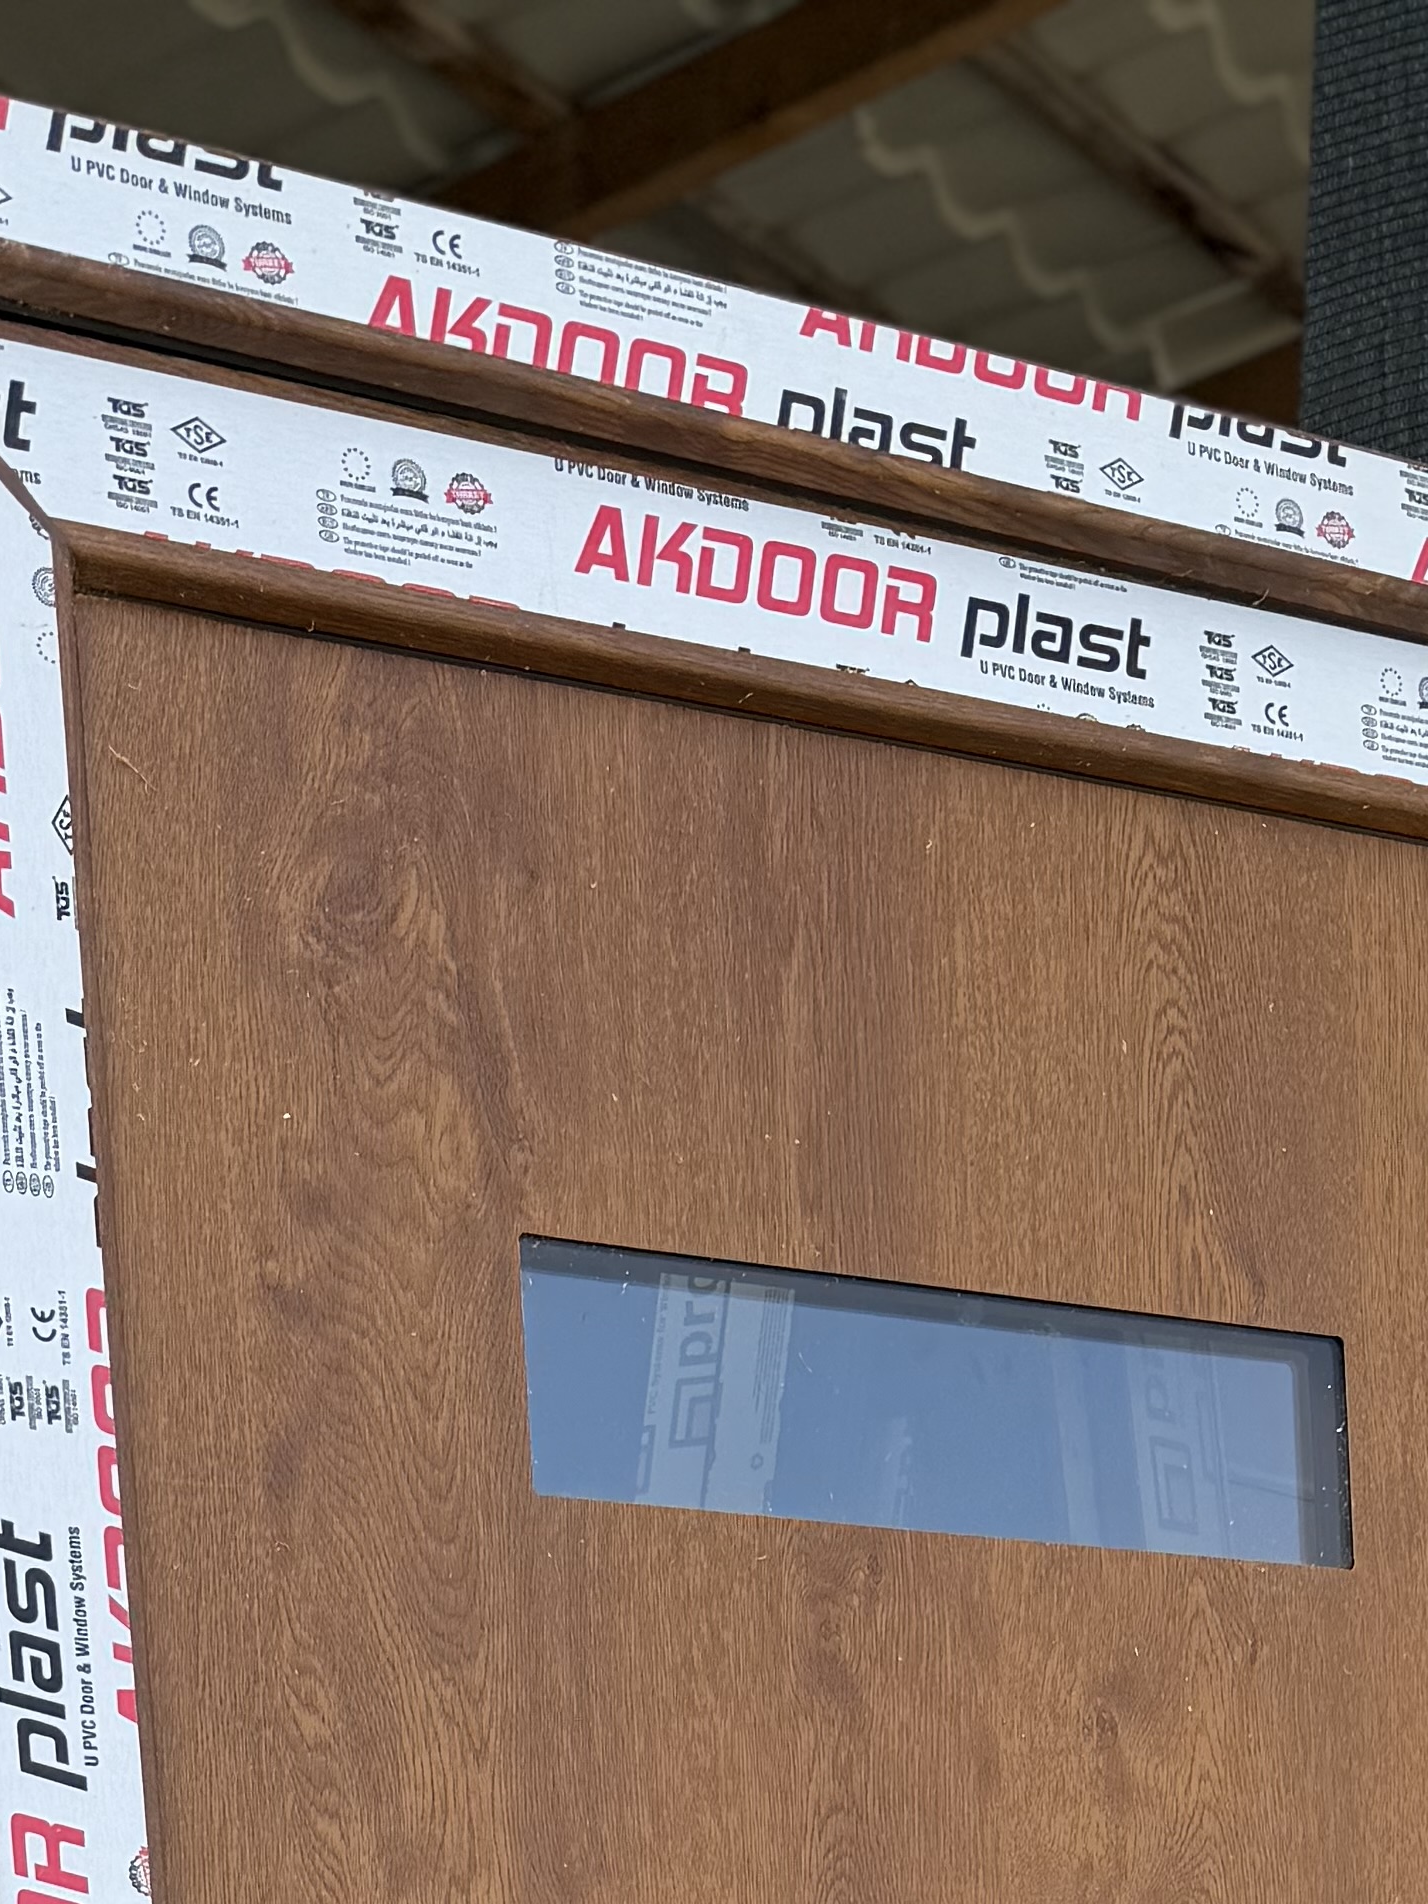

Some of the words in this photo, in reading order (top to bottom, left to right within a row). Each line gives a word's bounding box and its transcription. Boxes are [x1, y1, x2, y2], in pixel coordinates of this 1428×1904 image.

[574, 504, 938, 643] AKDOOR
[961, 595, 1150, 679] plast
[67, 1526, 87, 1592] Systems
[72, 1595, 90, 1657] Window
[76, 1662, 92, 1675] &
[79, 1677, 96, 1715] Door
[81, 1719, 99, 1751] PVC
[83, 1755, 100, 1767] U
